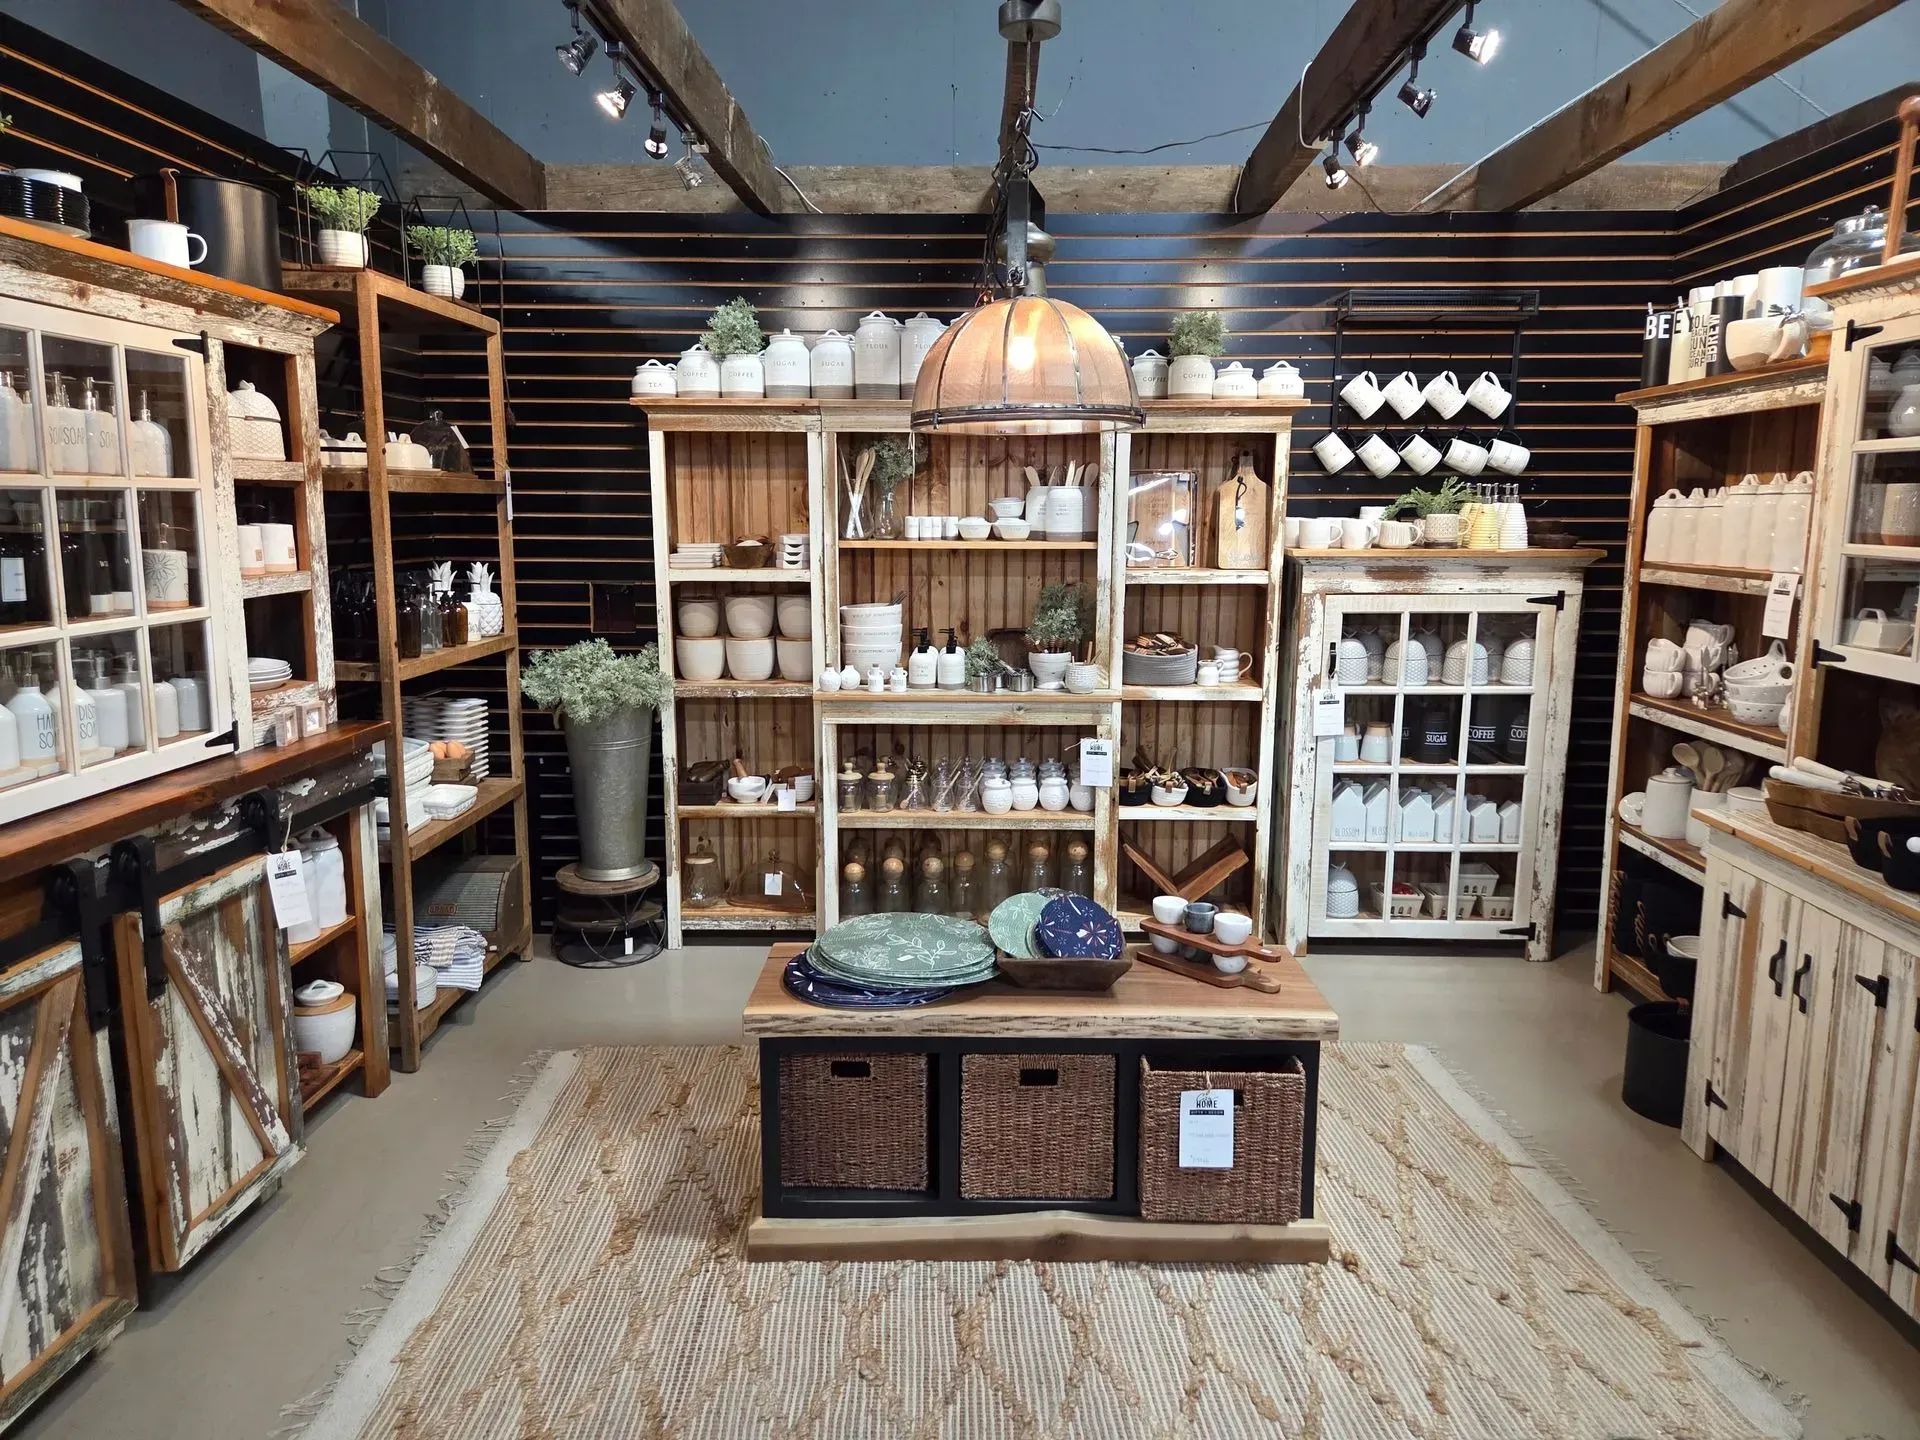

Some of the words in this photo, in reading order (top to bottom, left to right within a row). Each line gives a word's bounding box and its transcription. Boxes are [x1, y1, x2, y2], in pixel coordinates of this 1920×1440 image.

[1706, 314, 1721, 354] BREW
[1426, 734, 1448, 744] SUGAR
[1468, 729, 1495, 739] COFFEE
[1196, 1100, 1217, 1108] HOME
